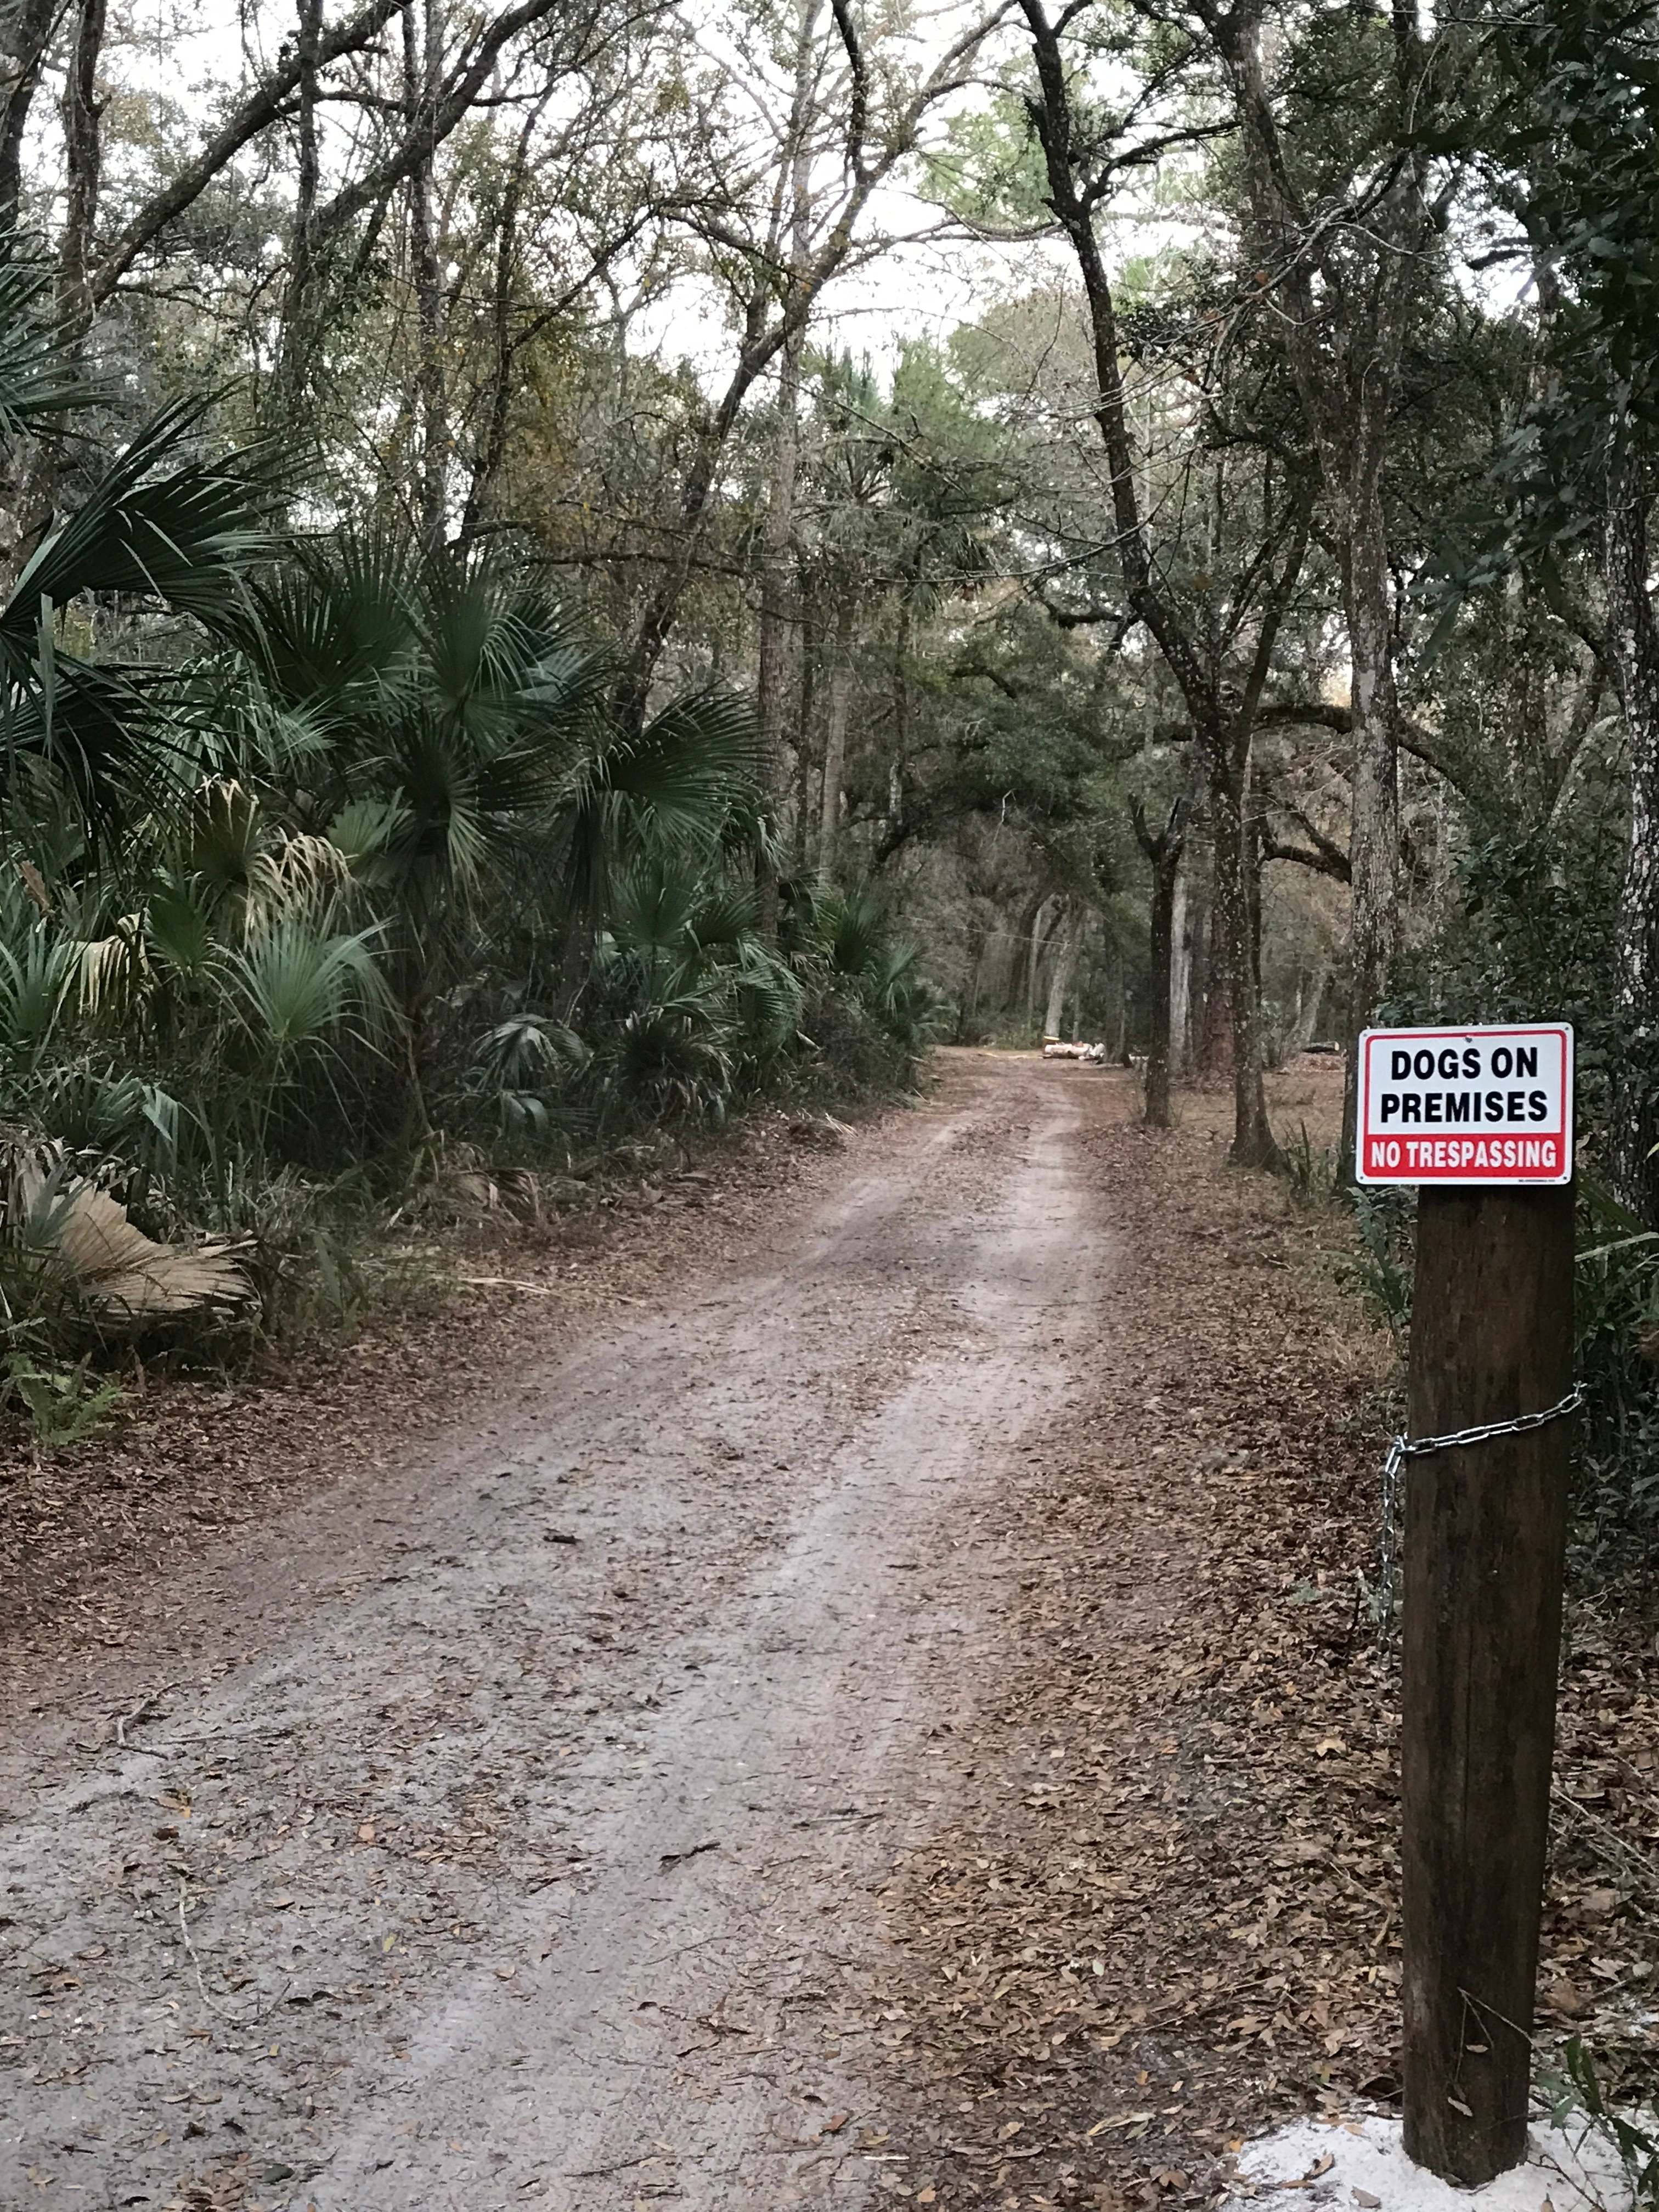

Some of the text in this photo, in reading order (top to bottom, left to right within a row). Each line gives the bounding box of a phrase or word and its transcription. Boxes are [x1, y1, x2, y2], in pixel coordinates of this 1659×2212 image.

[1392, 1047, 1537, 1080] DOGS ON
[1381, 1090, 1547, 1122] PREMISES
[1371, 1140, 1556, 1168] NO TRESPASSING
